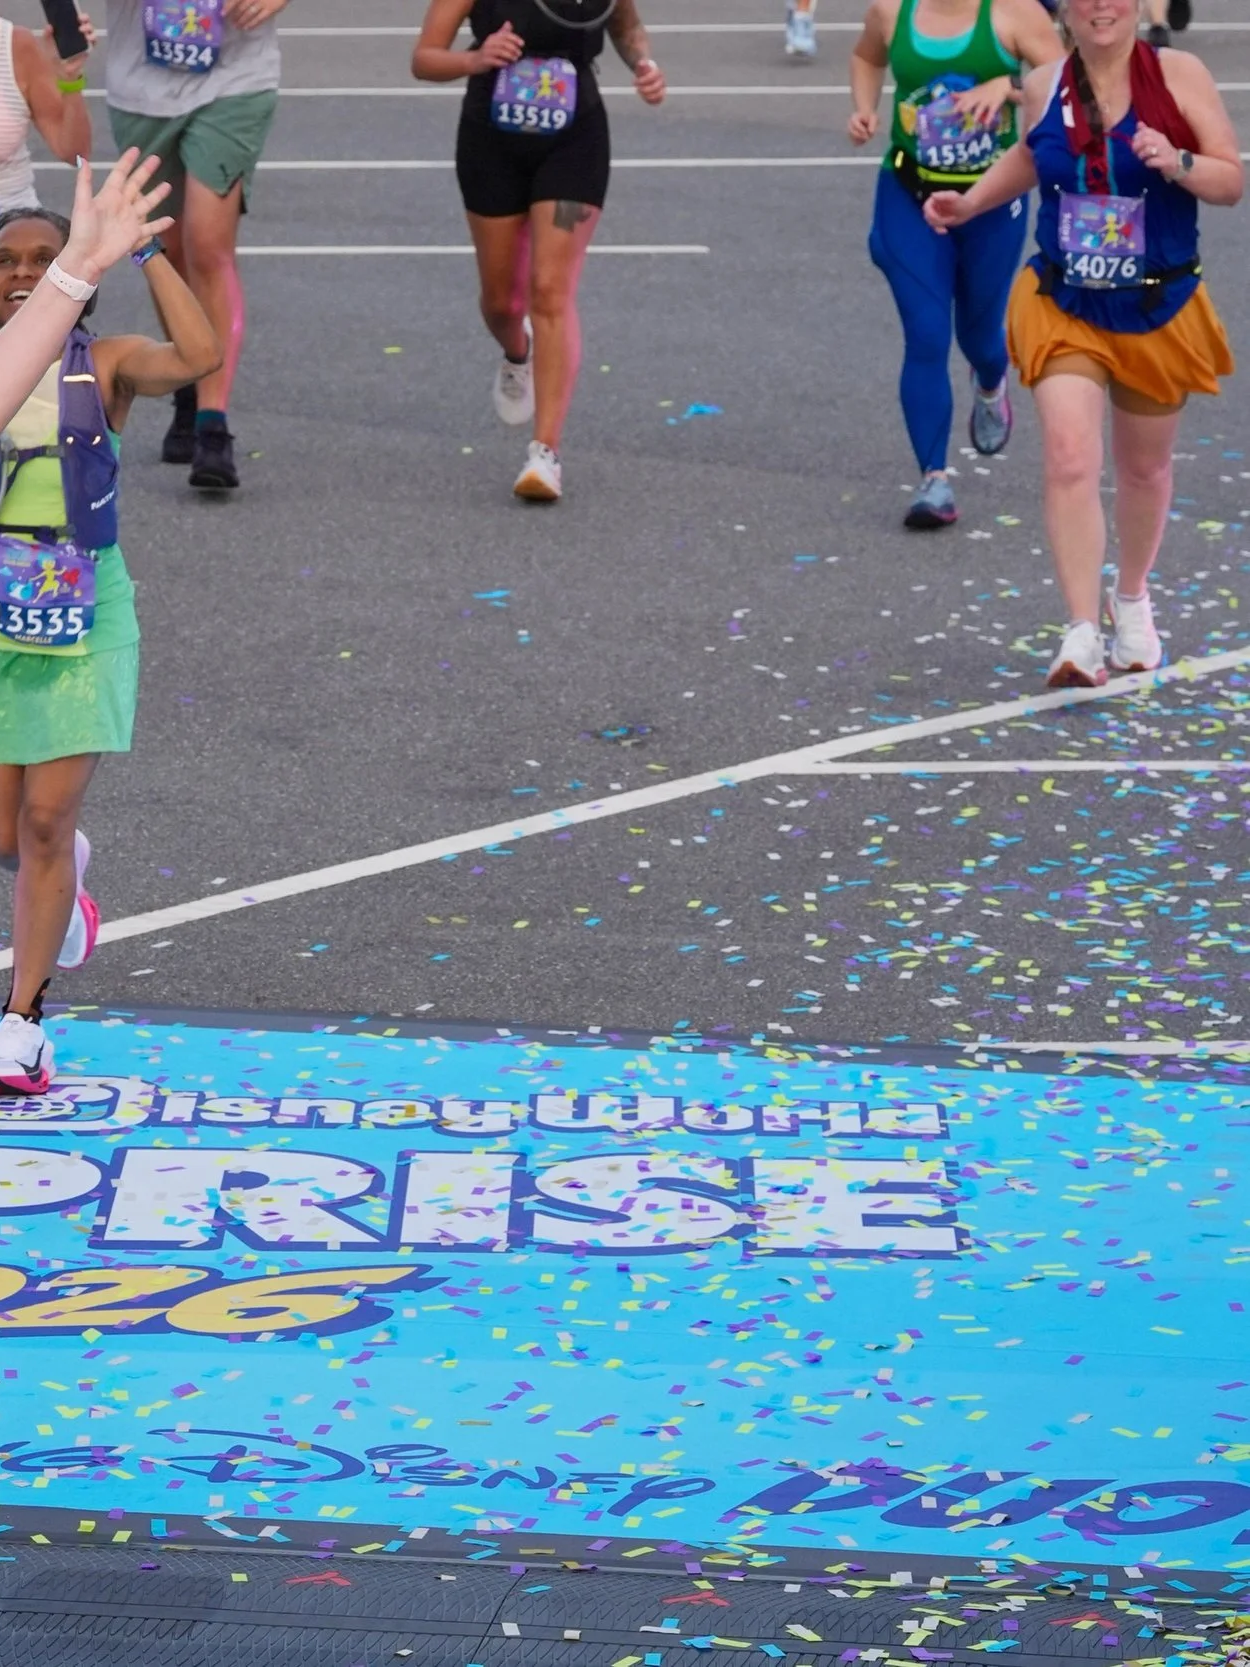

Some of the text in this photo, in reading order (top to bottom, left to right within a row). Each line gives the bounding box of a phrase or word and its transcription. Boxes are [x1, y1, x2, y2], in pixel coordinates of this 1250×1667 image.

[151, 39, 213, 66] 13524
[498, 102, 567, 129] 13519
[927, 132, 992, 167] 15344
[1065, 252, 1137, 279] 14076
